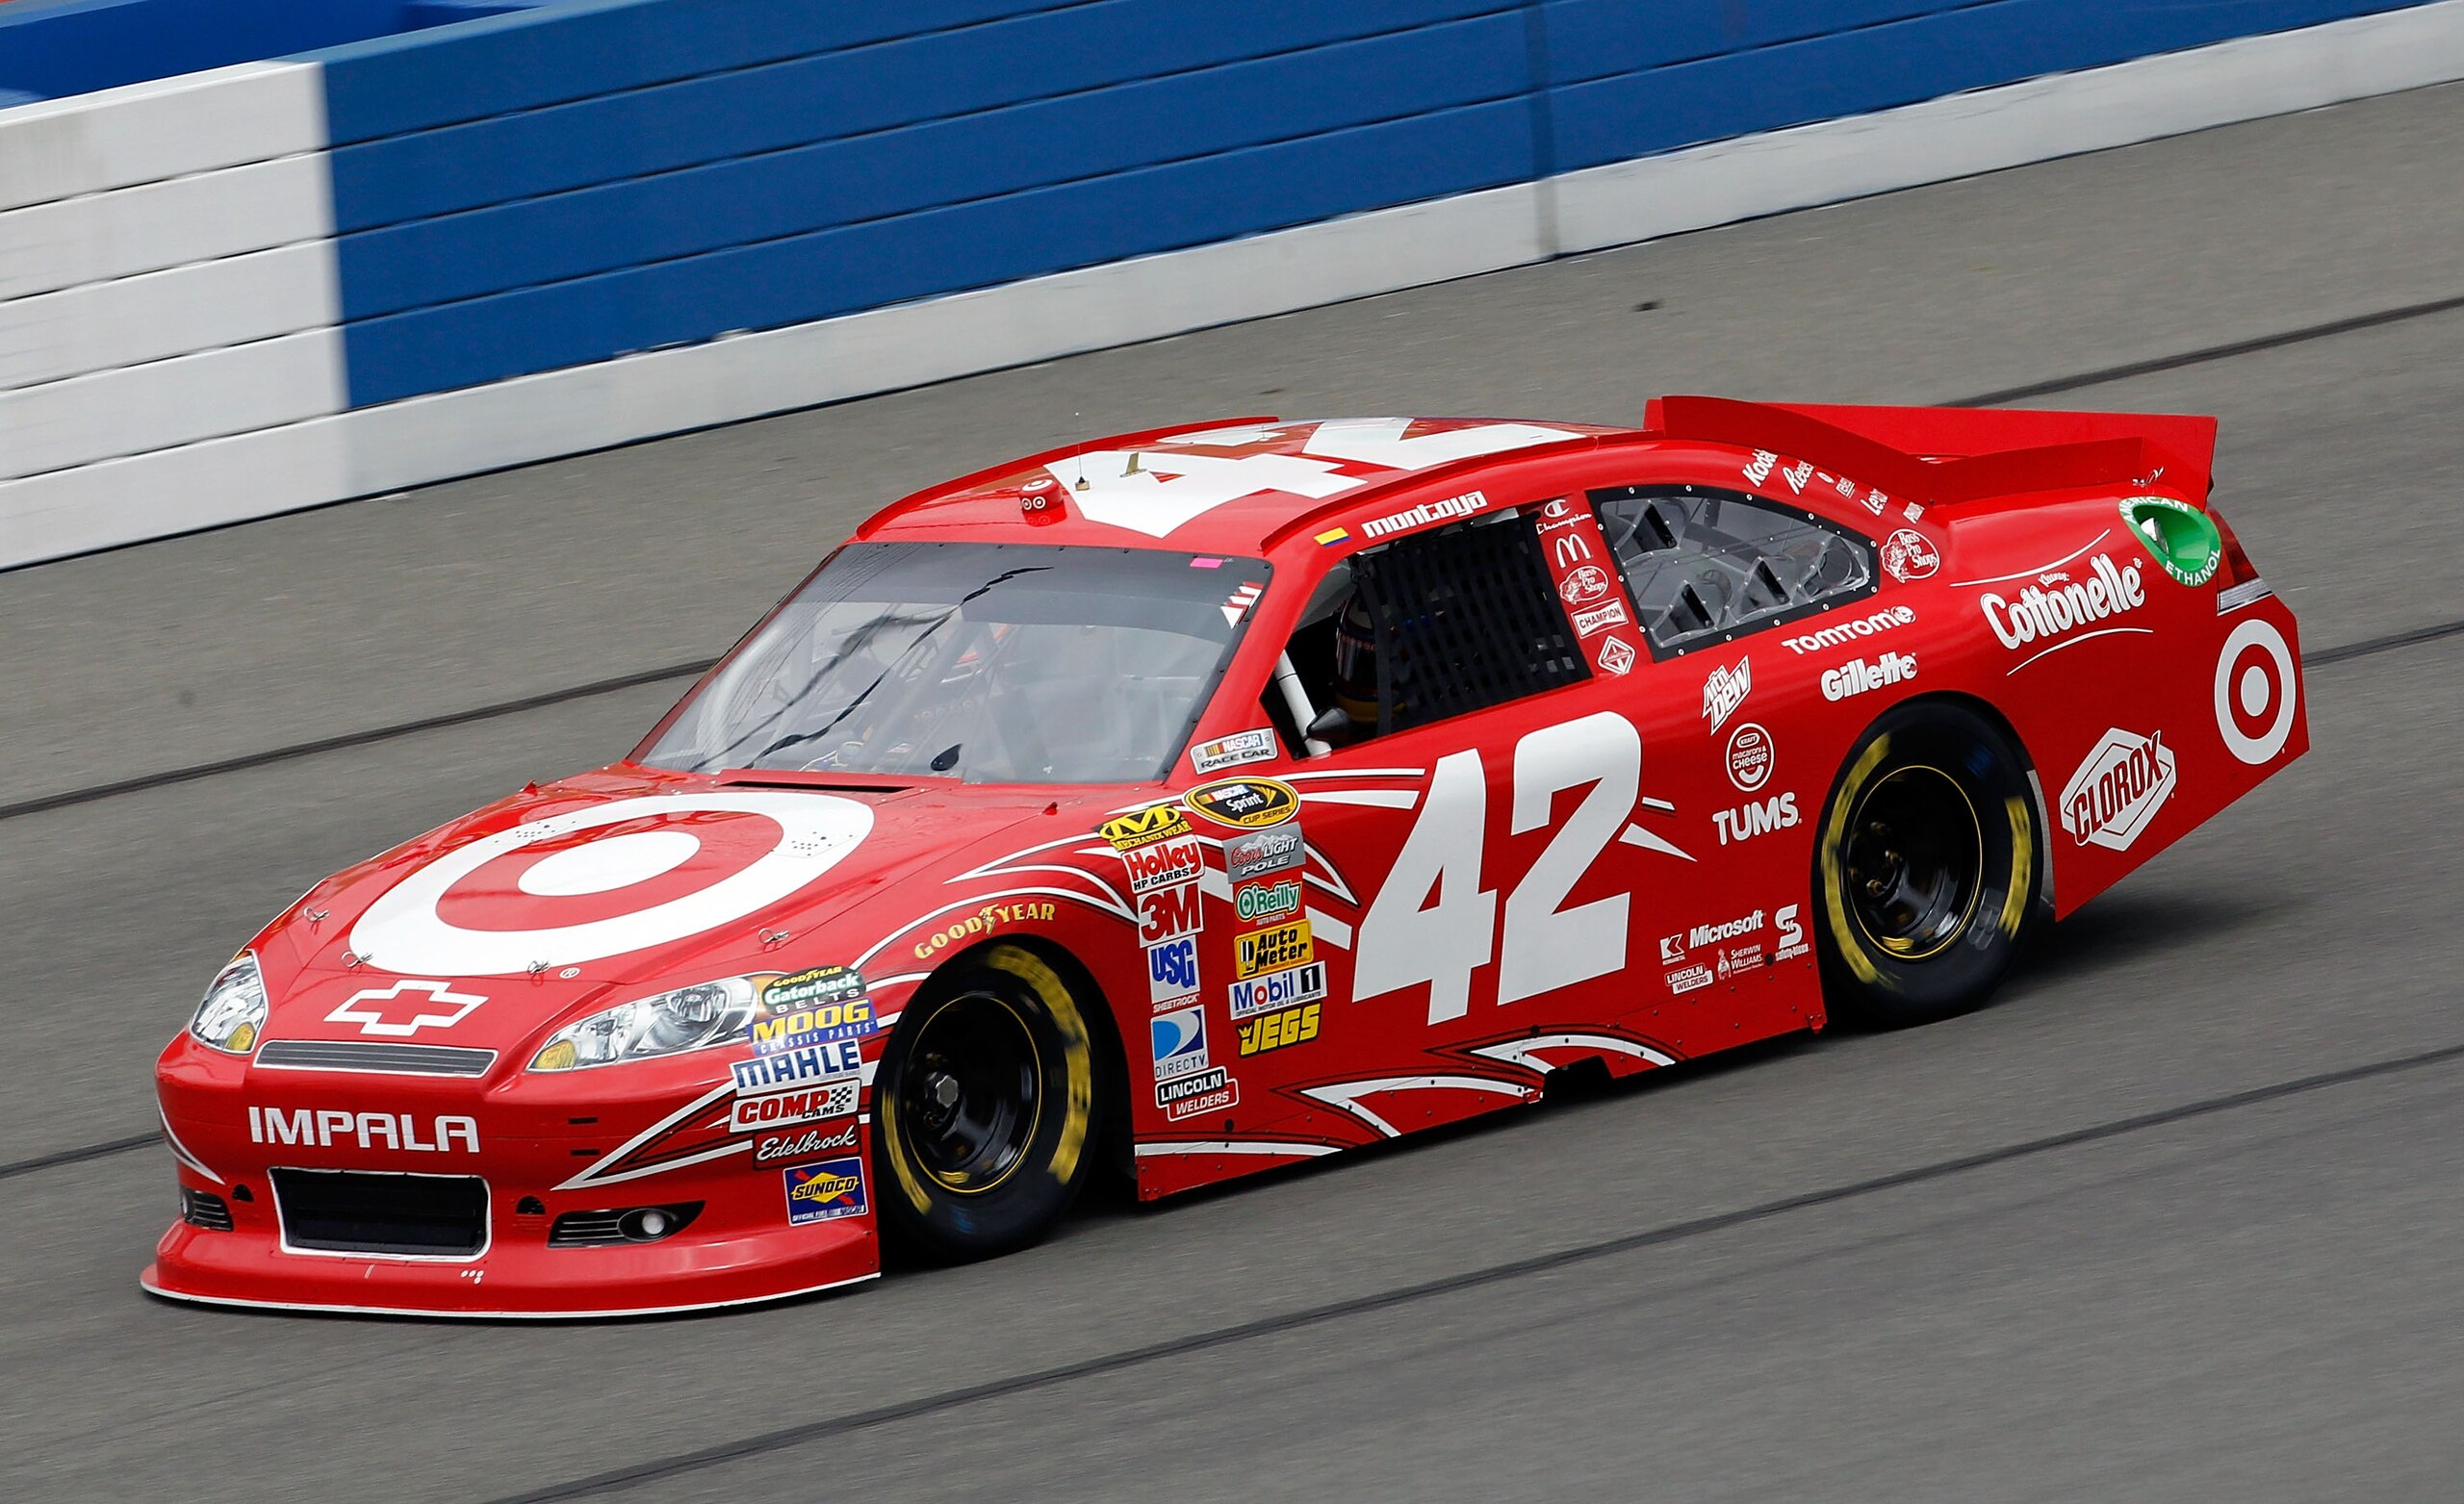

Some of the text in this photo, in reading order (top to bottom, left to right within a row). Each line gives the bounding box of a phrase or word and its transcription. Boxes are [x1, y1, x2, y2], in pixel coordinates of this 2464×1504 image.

[1360, 490, 1488, 539] montoya
[1535, 513, 1592, 535] Champion
[2118, 496, 2189, 525] AMERICAN
[1898, 532, 1920, 546] Bass
[1906, 544, 1922, 557] Pro
[1912, 552, 1938, 569] Shops
[2166, 549, 2220, 586] ETHANOL
[1980, 553, 2145, 650] Cottonelle
[1578, 606, 1622, 629] CHAMPION
[1821, 651, 1917, 701] Gillette
[1222, 733, 1263, 754] NASCAR
[1200, 749, 1270, 768] RACE CAR
[1225, 792, 1264, 813] Sprint
[2072, 731, 2163, 846] CLOROX
[1243, 806, 1293, 825] CUP SERIES
[1712, 792, 1801, 847] TUMS
[1110, 819, 1194, 852] MECHANIX WEAR
[1263, 837, 1299, 859] LIGHT
[1124, 842, 1202, 881] Holley
[1240, 854, 1292, 878] POLE
[1352, 710, 1642, 1026] 42
[1133, 867, 1191, 891] HP CARBS
[1142, 885, 1200, 941] 3M
[1237, 884, 1300, 919] O'Reilly
[914, 903, 1057, 959] GOODYEAR
[1257, 929, 1298, 953] Auto
[1689, 909, 1765, 950] Microsoft
[1150, 939, 1196, 989] USG
[1254, 942, 1308, 971] Meter
[773, 965, 844, 987] GOODYEAR
[1666, 964, 1704, 984] LINCOLN
[1677, 975, 1708, 991] WELDERS
[764, 972, 862, 1006] Gatorback
[775, 988, 860, 1015] BELTS
[1153, 993, 1199, 1013] SHEETROCK
[1233, 971, 1295, 1011] Mobil
[752, 999, 869, 1044] MOOG
[828, 1022, 871, 1040] PARTS
[1240, 1003, 1322, 1056] JEGS
[733, 1040, 860, 1089] MAHLE
[1155, 1054, 1206, 1078] DIRECTV
[1160, 1073, 1222, 1103] LINCOLN
[737, 1089, 830, 1125] COMP
[801, 1104, 845, 1119] CAMS
[1176, 1090, 1230, 1116] WELDERS
[248, 1106, 480, 1154] IMPALA
[756, 1124, 857, 1161] Edelbrock
[794, 1178, 856, 1199] SUNOCO
